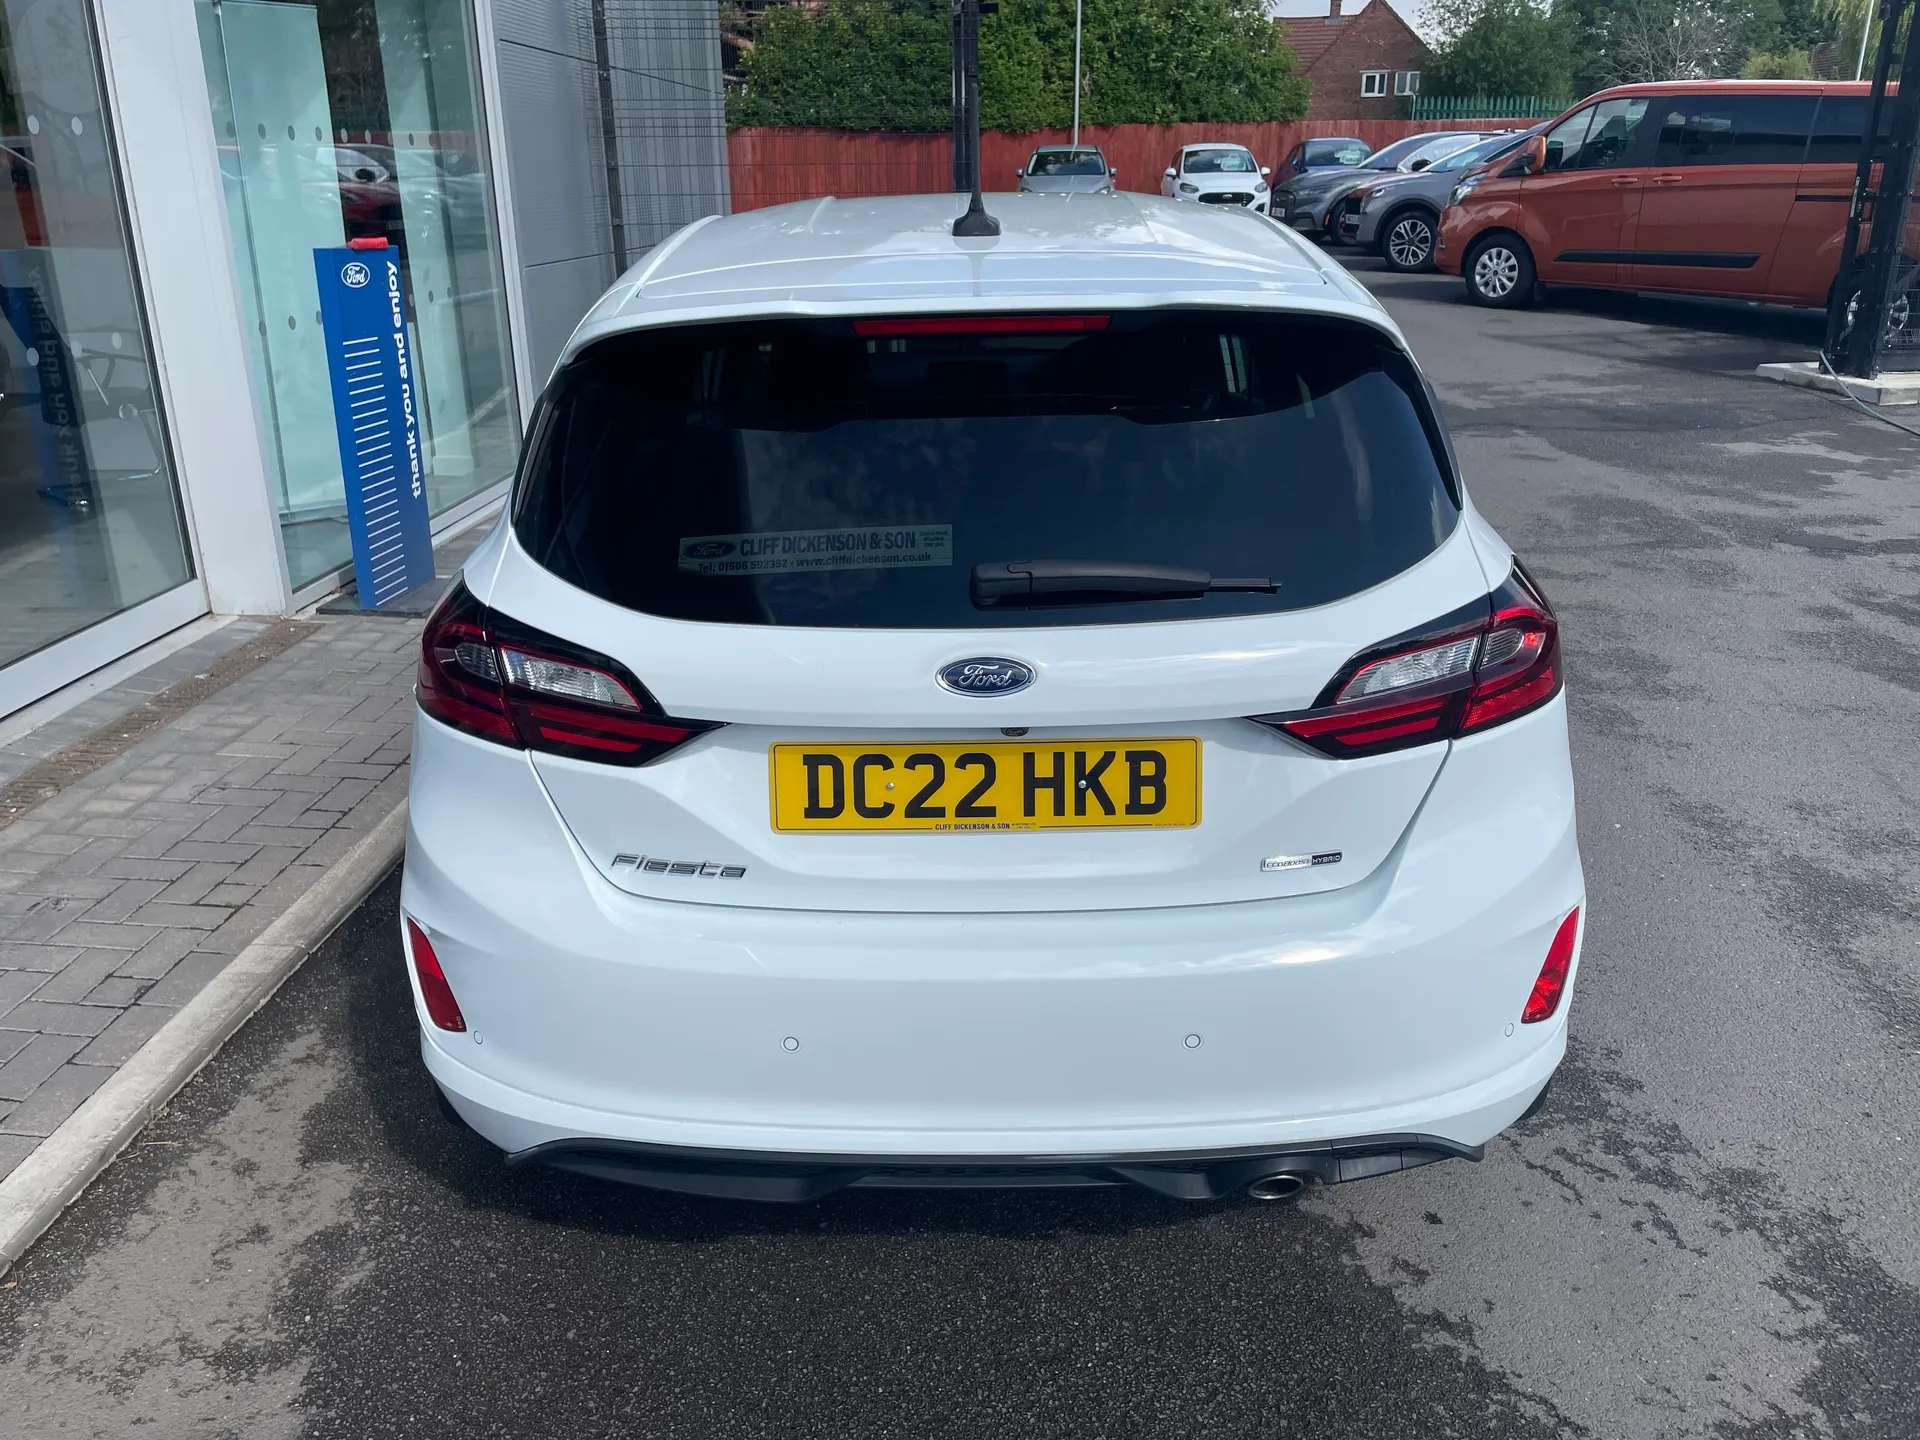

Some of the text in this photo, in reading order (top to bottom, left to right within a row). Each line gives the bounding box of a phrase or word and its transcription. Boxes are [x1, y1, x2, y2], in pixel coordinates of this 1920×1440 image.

[346, 266, 366, 283] Ford
[387, 260, 422, 498] thank you and enjoy
[740, 536, 780, 557] CLIFF
[782, 532, 867, 554] DICKENSON
[869, 532, 883, 550] &
[885, 530, 917, 550] SON
[958, 664, 1013, 687] Ford
[802, 750, 1168, 819] DC22 HKB
[935, 823, 951, 831] CLIFF
[954, 822, 990, 831] DICKENSON
[997, 822, 1010, 830] SON
[611, 852, 747, 879] Fiesta
